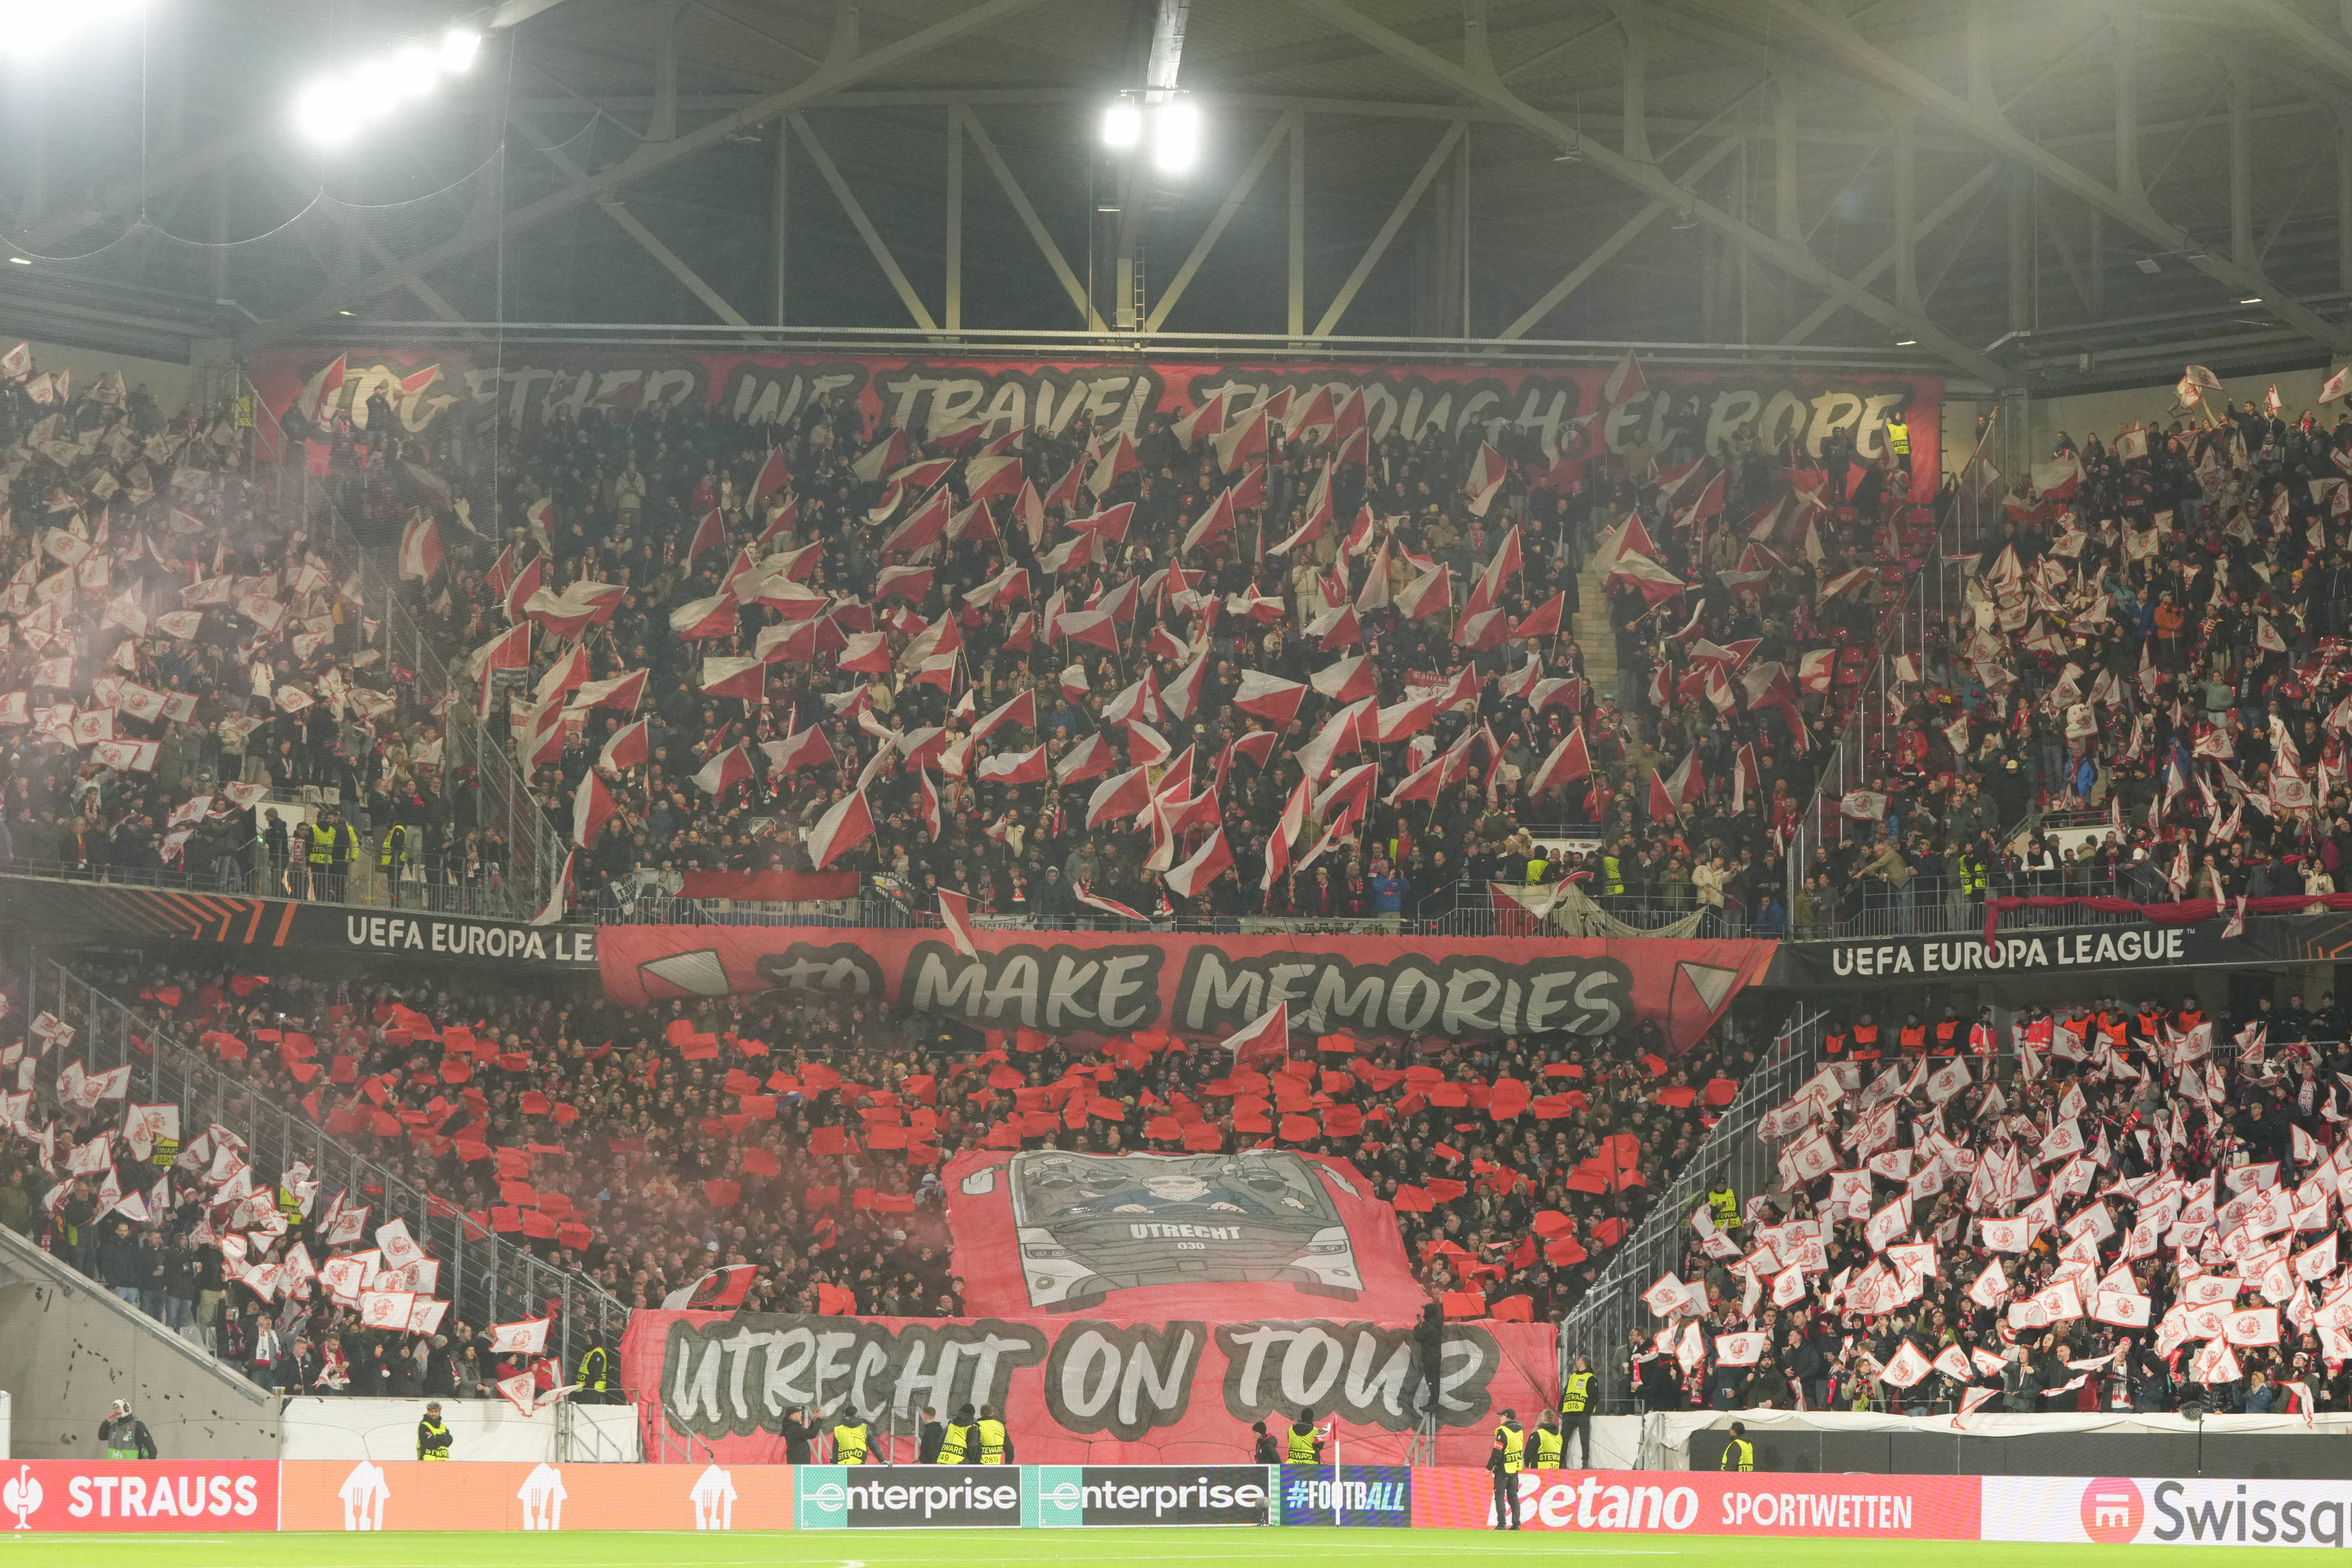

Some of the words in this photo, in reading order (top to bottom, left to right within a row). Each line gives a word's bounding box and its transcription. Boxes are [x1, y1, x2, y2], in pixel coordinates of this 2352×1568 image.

[887, 375, 1150, 449] TRAVEL
[348, 915, 424, 950] UEFA
[432, 922, 547, 959] EUROPA
[556, 932, 599, 961] LE
[1833, 947, 1915, 975] UEFA
[1923, 939, 2049, 972] EUROPA
[2058, 928, 2184, 965] LEAGUE
[913, 952, 1150, 1028] MAKE
[1185, 952, 1622, 1035] MEMORIES
[1130, 1223, 1240, 1241] UTRECHT
[1178, 1241, 1205, 1251] 030
[672, 1326, 1033, 1422] UTRECHT
[1061, 1329, 1195, 1426] ON
[1230, 1326, 1475, 1417] TOUR
[941, 1444, 964, 1455] EWARD
[68, 1475, 257, 1518] STRAUSS
[814, 1477, 1017, 1519] enterprise
[1051, 1476, 1265, 1517] enterprise
[1286, 1479, 1405, 1512] #FOOTBALL
[1486, 1476, 1699, 1530] Betano
[1721, 1492, 1912, 1529] SPORTWETTEN
[2153, 1480, 2352, 1548] Swissq
